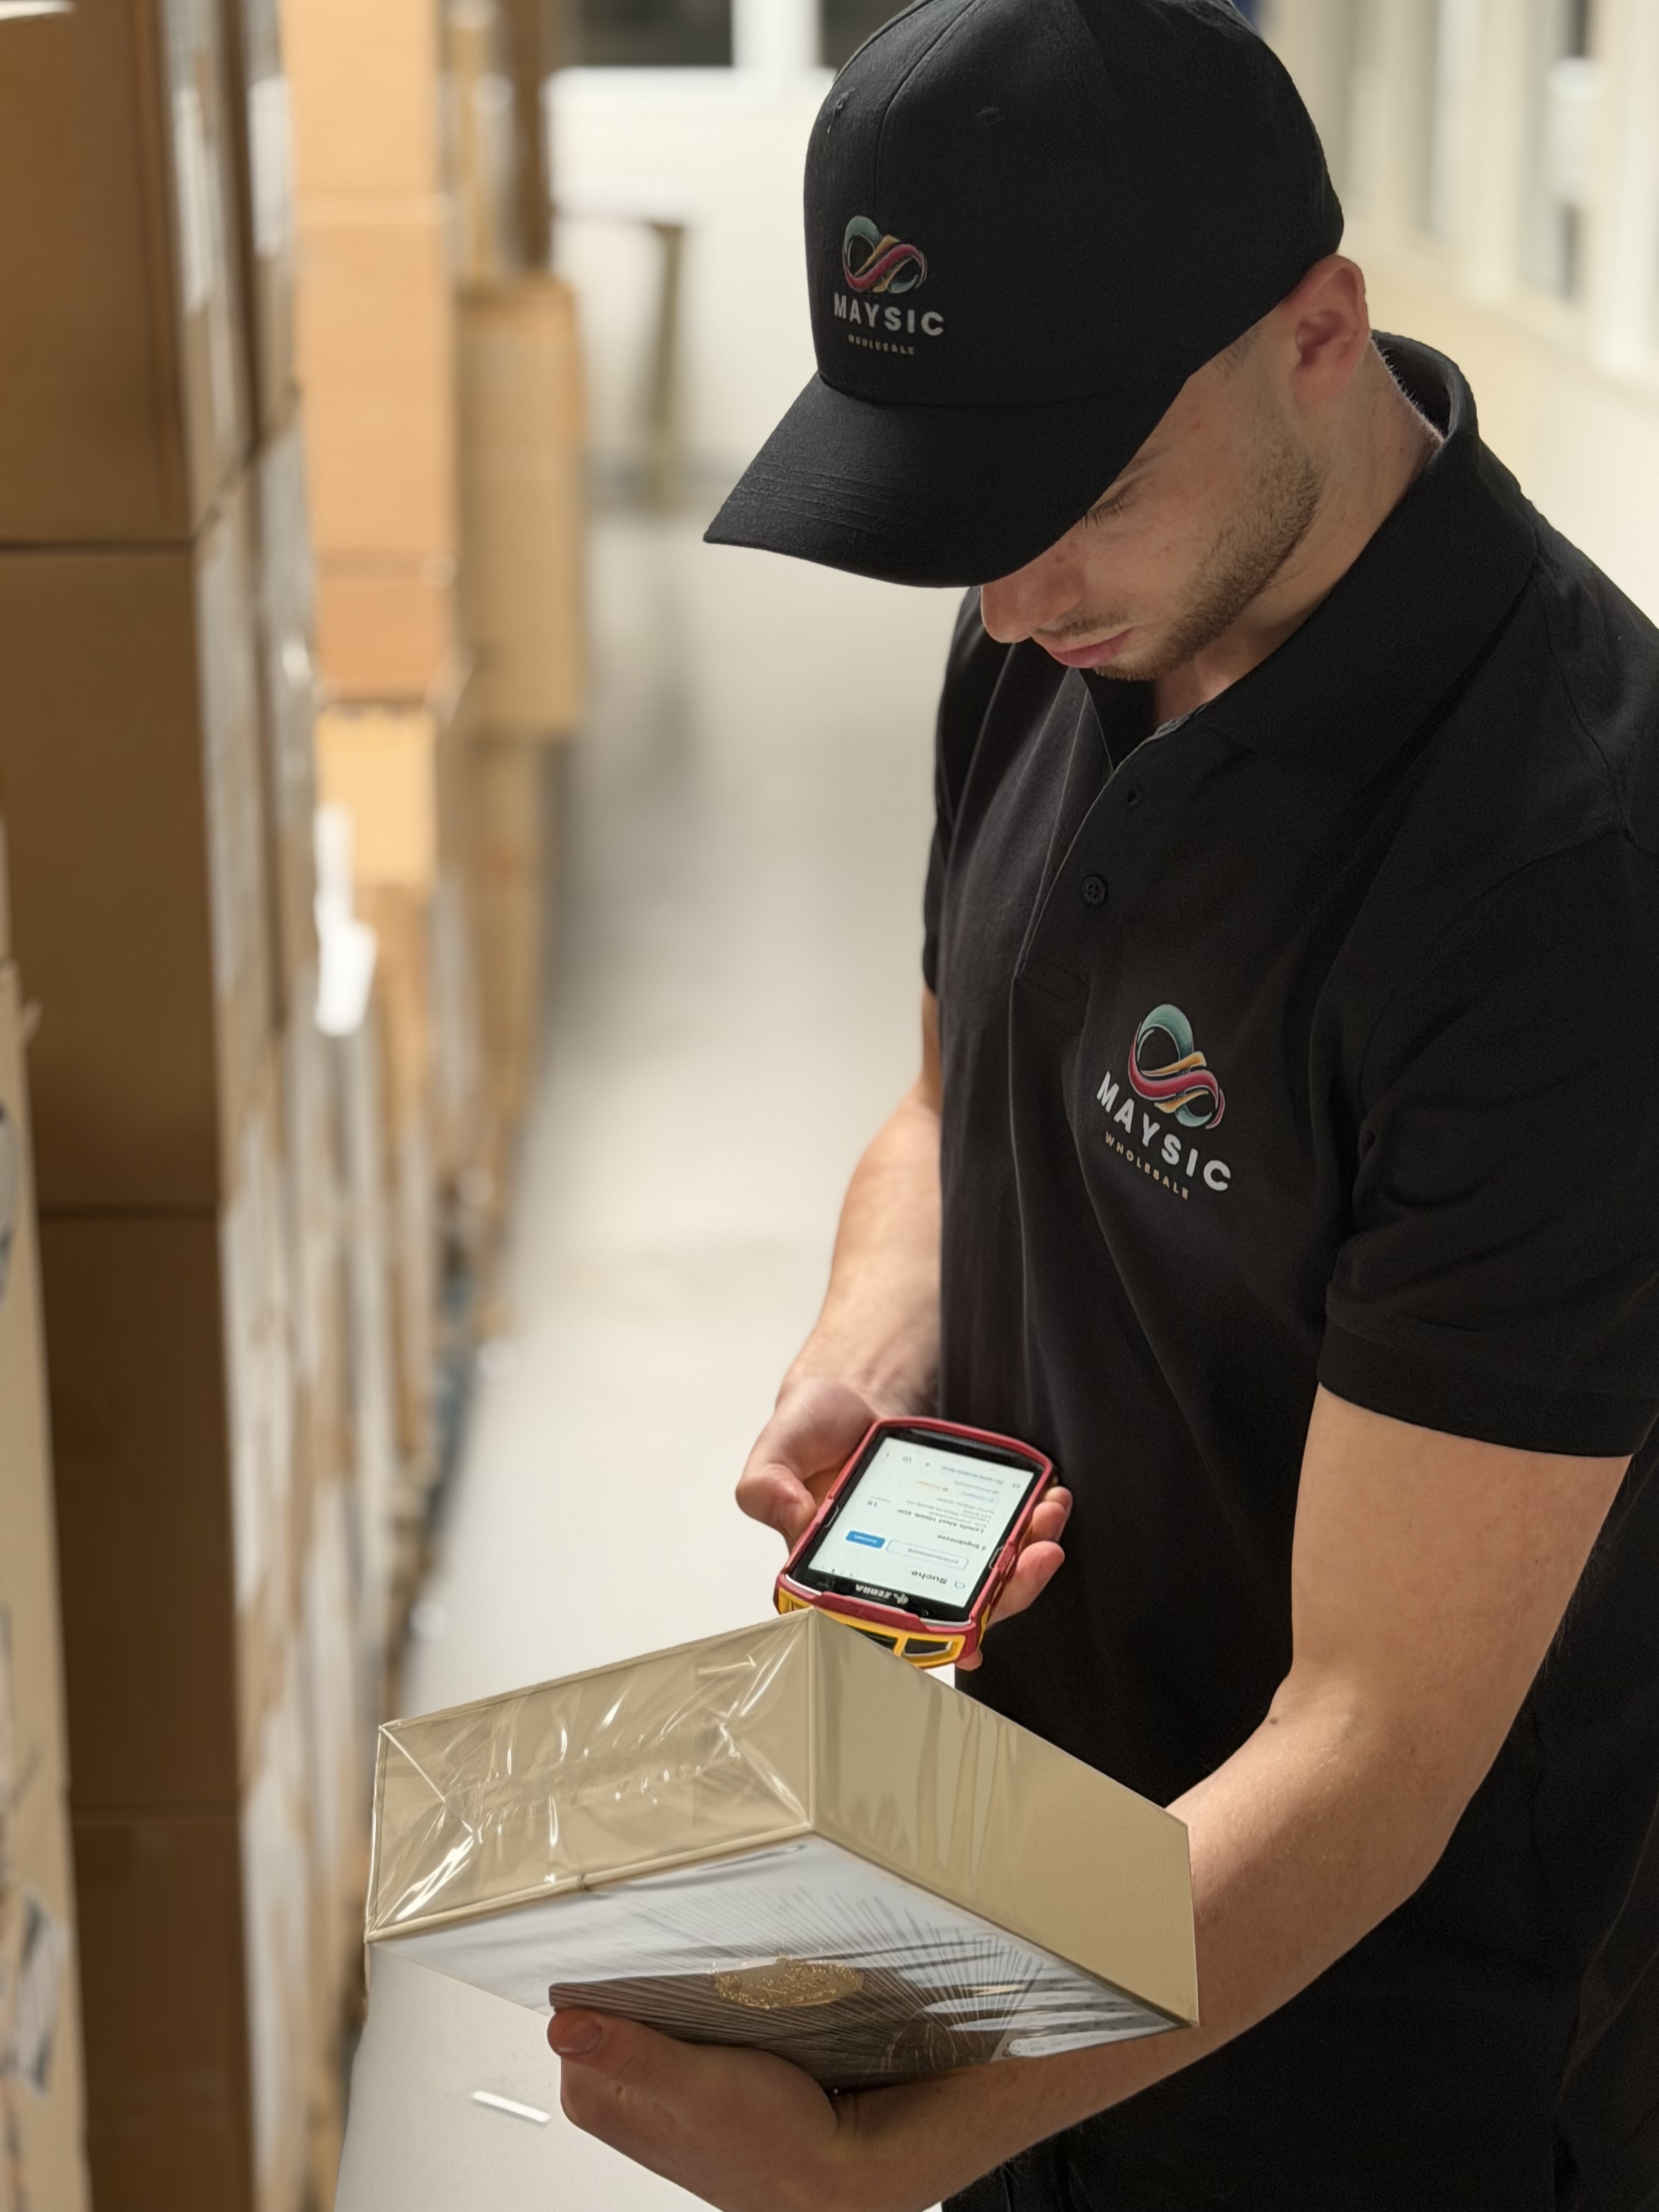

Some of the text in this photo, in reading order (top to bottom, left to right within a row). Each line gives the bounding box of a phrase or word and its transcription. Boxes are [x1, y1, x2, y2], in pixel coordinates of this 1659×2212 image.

[834, 292, 944, 336] MAYSIC
[1097, 1071, 1231, 1191] MAYSIC
[1105, 1132, 1189, 1200] WHOLESALE
